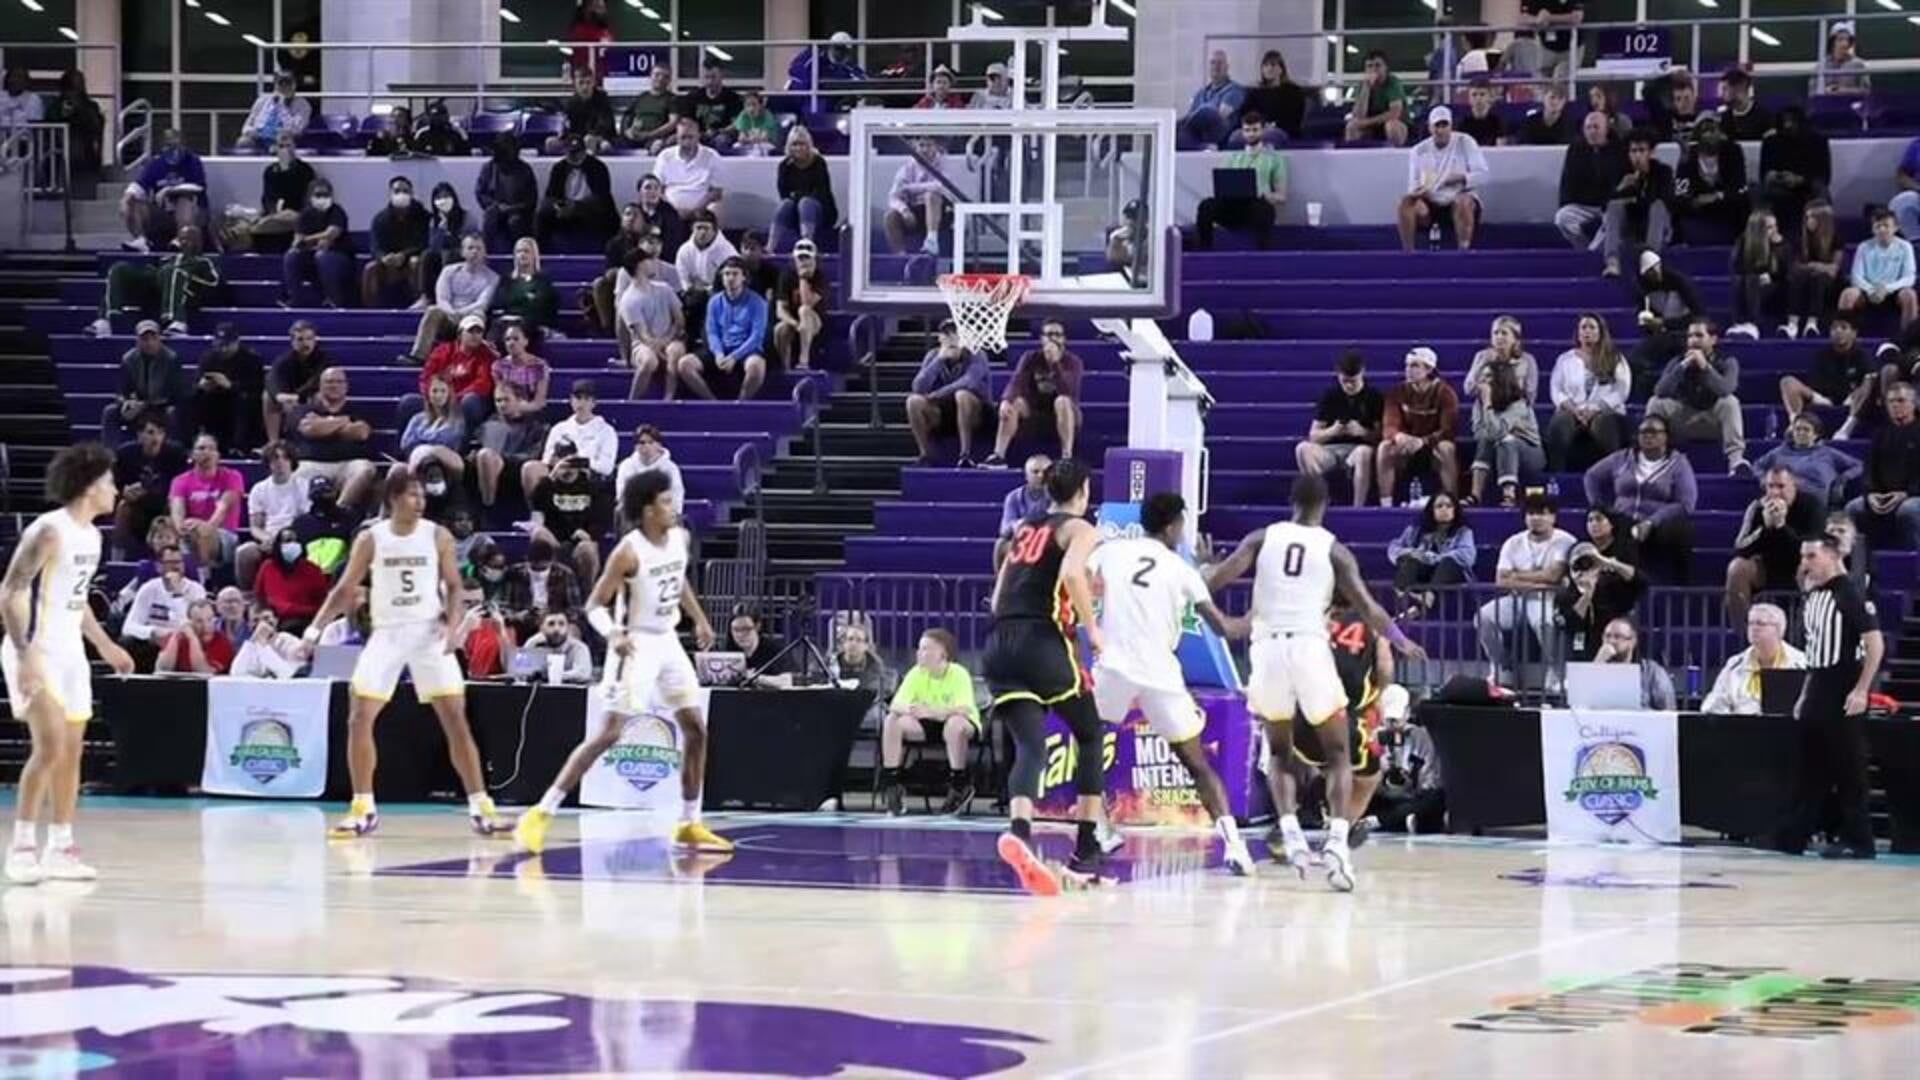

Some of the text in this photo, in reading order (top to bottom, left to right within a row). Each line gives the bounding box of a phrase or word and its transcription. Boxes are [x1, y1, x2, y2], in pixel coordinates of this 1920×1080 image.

[1625, 33, 1658, 53] 102
[629, 54, 656, 71] 101
[1009, 524, 1051, 564] 30
[1131, 557, 1157, 588] 2
[1284, 542, 1305, 577] 0
[400, 569, 415, 593] 5
[658, 576, 681, 603] 23
[1135, 736, 1181, 765] MO
[1132, 764, 1195, 790] INTENS
[1152, 788, 1202, 805] SNACK
